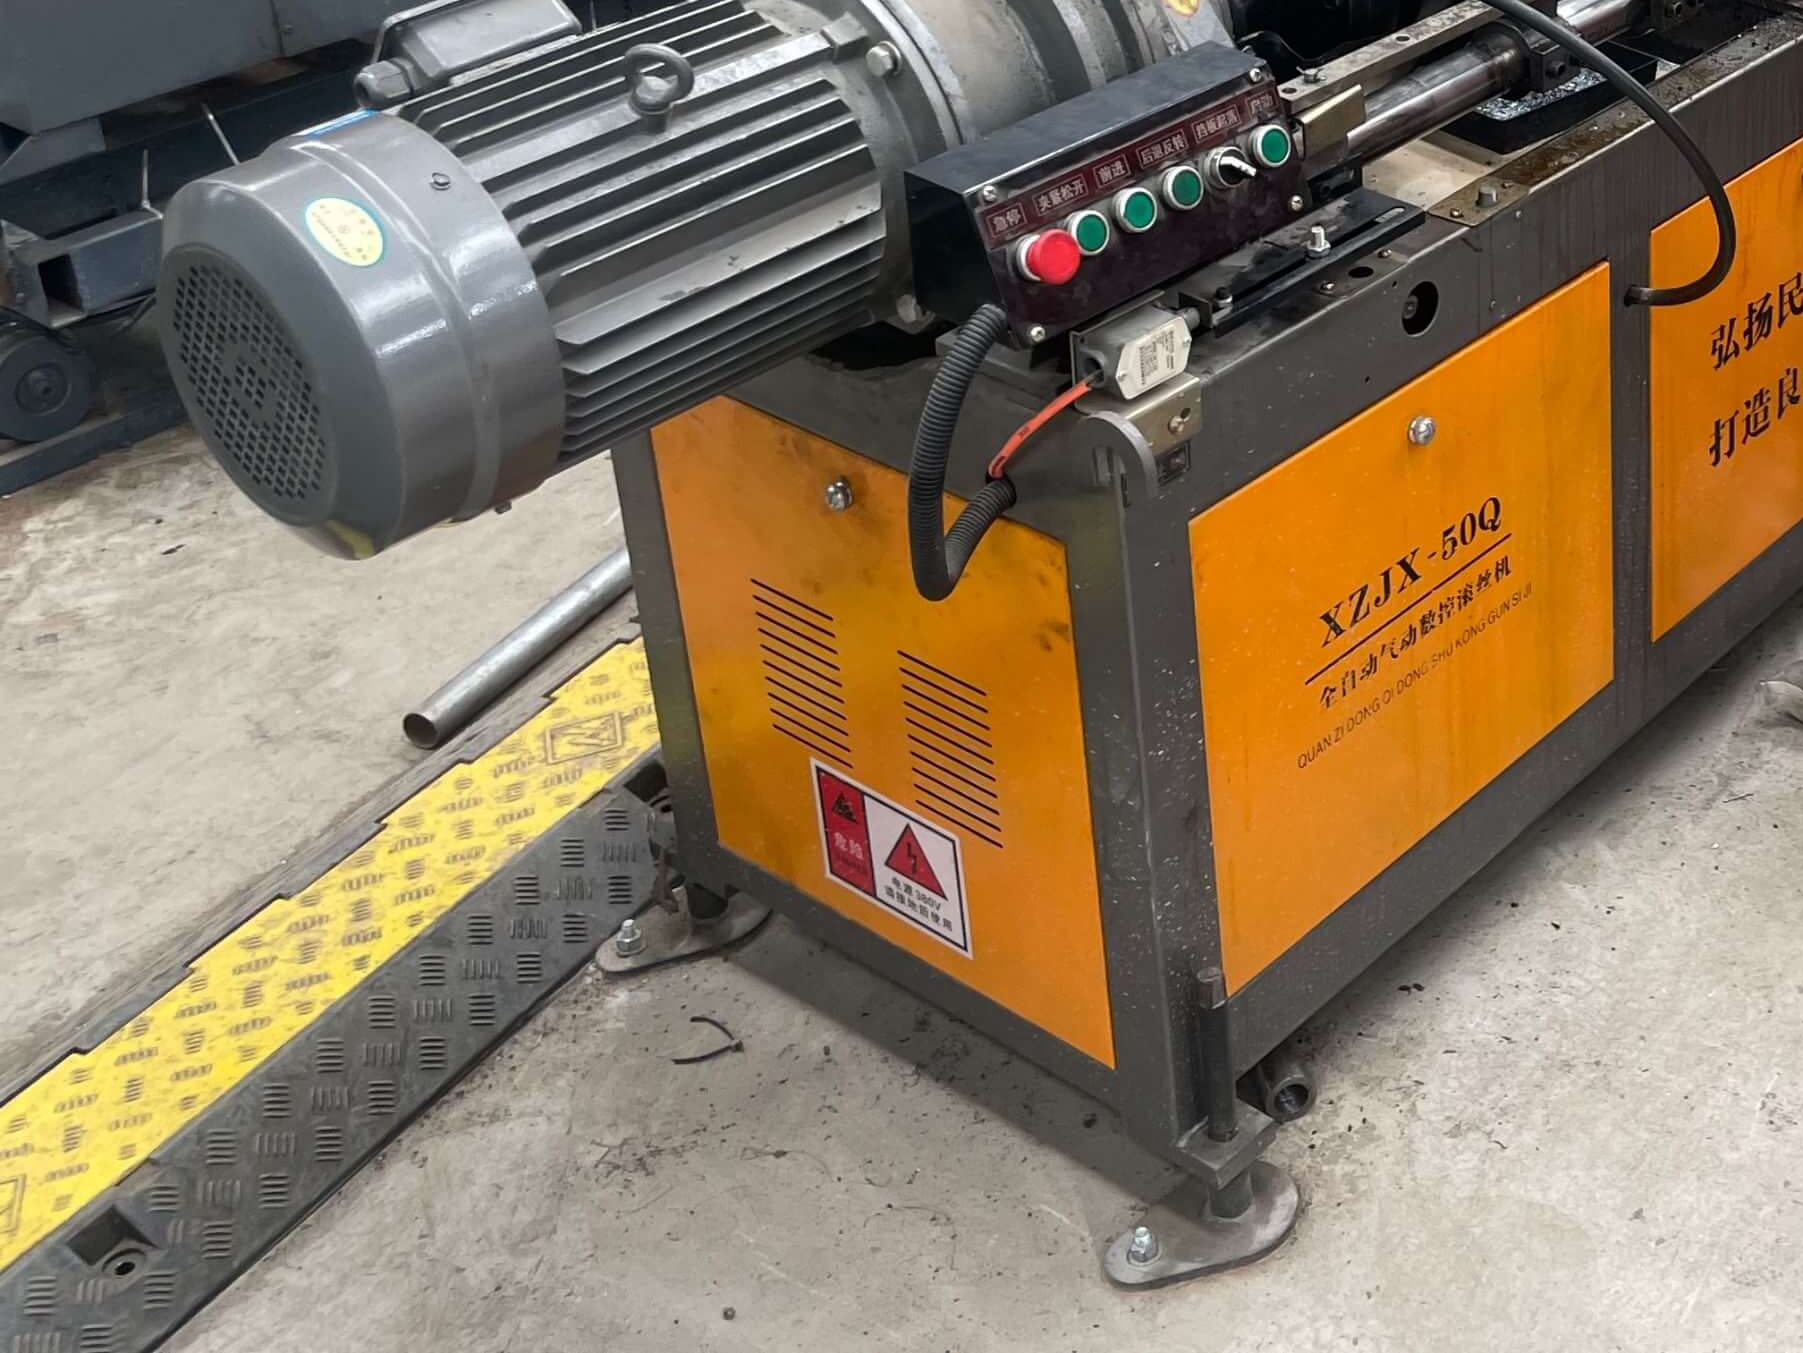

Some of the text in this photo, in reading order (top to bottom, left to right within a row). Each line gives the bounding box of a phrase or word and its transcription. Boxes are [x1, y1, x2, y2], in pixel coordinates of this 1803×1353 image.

[1140, 132, 1186, 165] 后退反转
[1099, 162, 1127, 184] 前进
[1037, 178, 1086, 210] 夹紧松开
[992, 208, 1023, 232] 急停
[1297, 734, 1332, 770] QUAN
[1346, 697, 1381, 733] DONG
[1396, 661, 1430, 695] DONG
[1431, 644, 1454, 668] SHU
[1455, 619, 1487, 649] KONG
[1487, 600, 1510, 625] GUN
[833, 831, 865, 861] 危险
